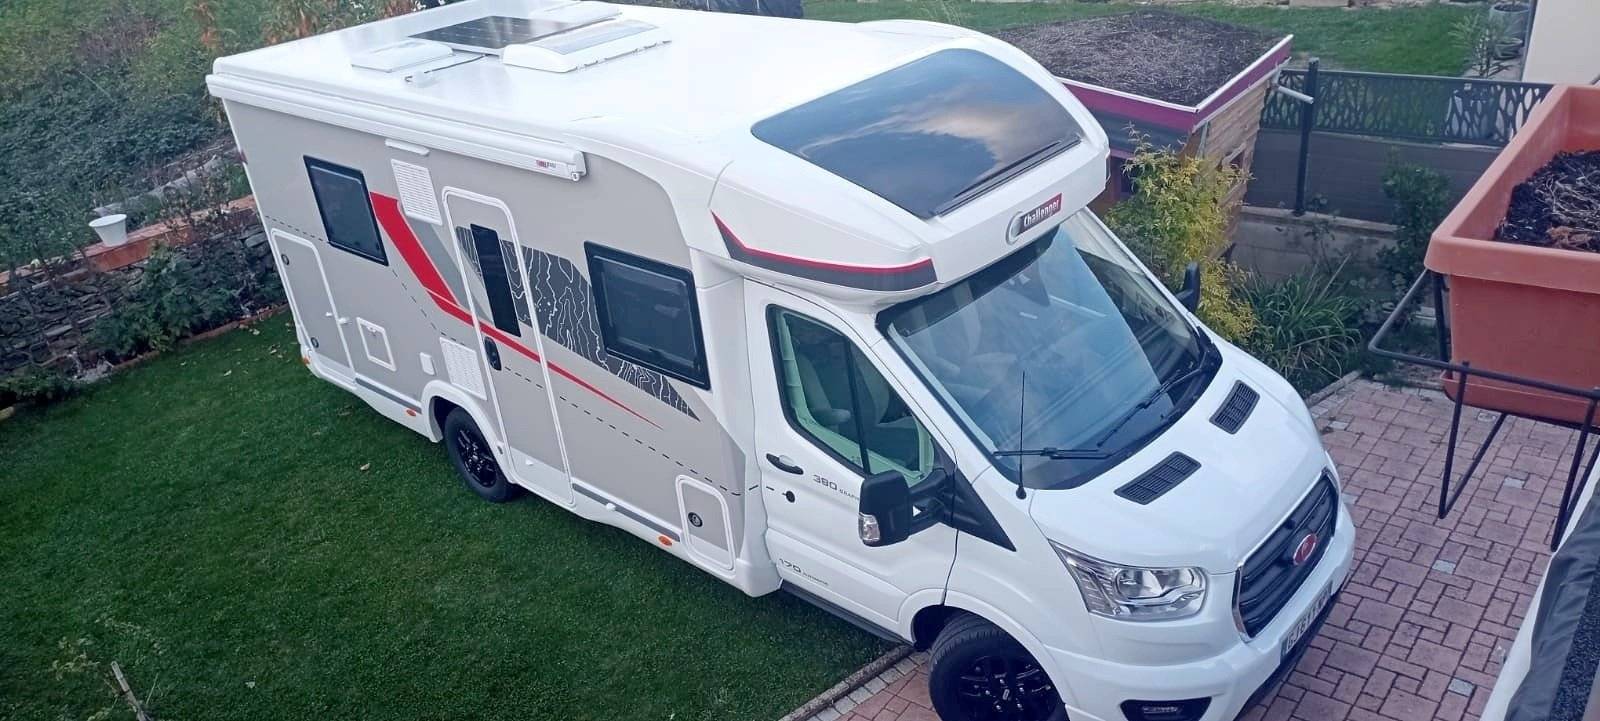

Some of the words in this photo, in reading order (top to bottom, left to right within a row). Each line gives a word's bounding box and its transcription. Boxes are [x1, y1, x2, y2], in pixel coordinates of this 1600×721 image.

[1023, 199, 1060, 227] Challenger
[812, 474, 838, 490] 380
[779, 558, 801, 573] 170
